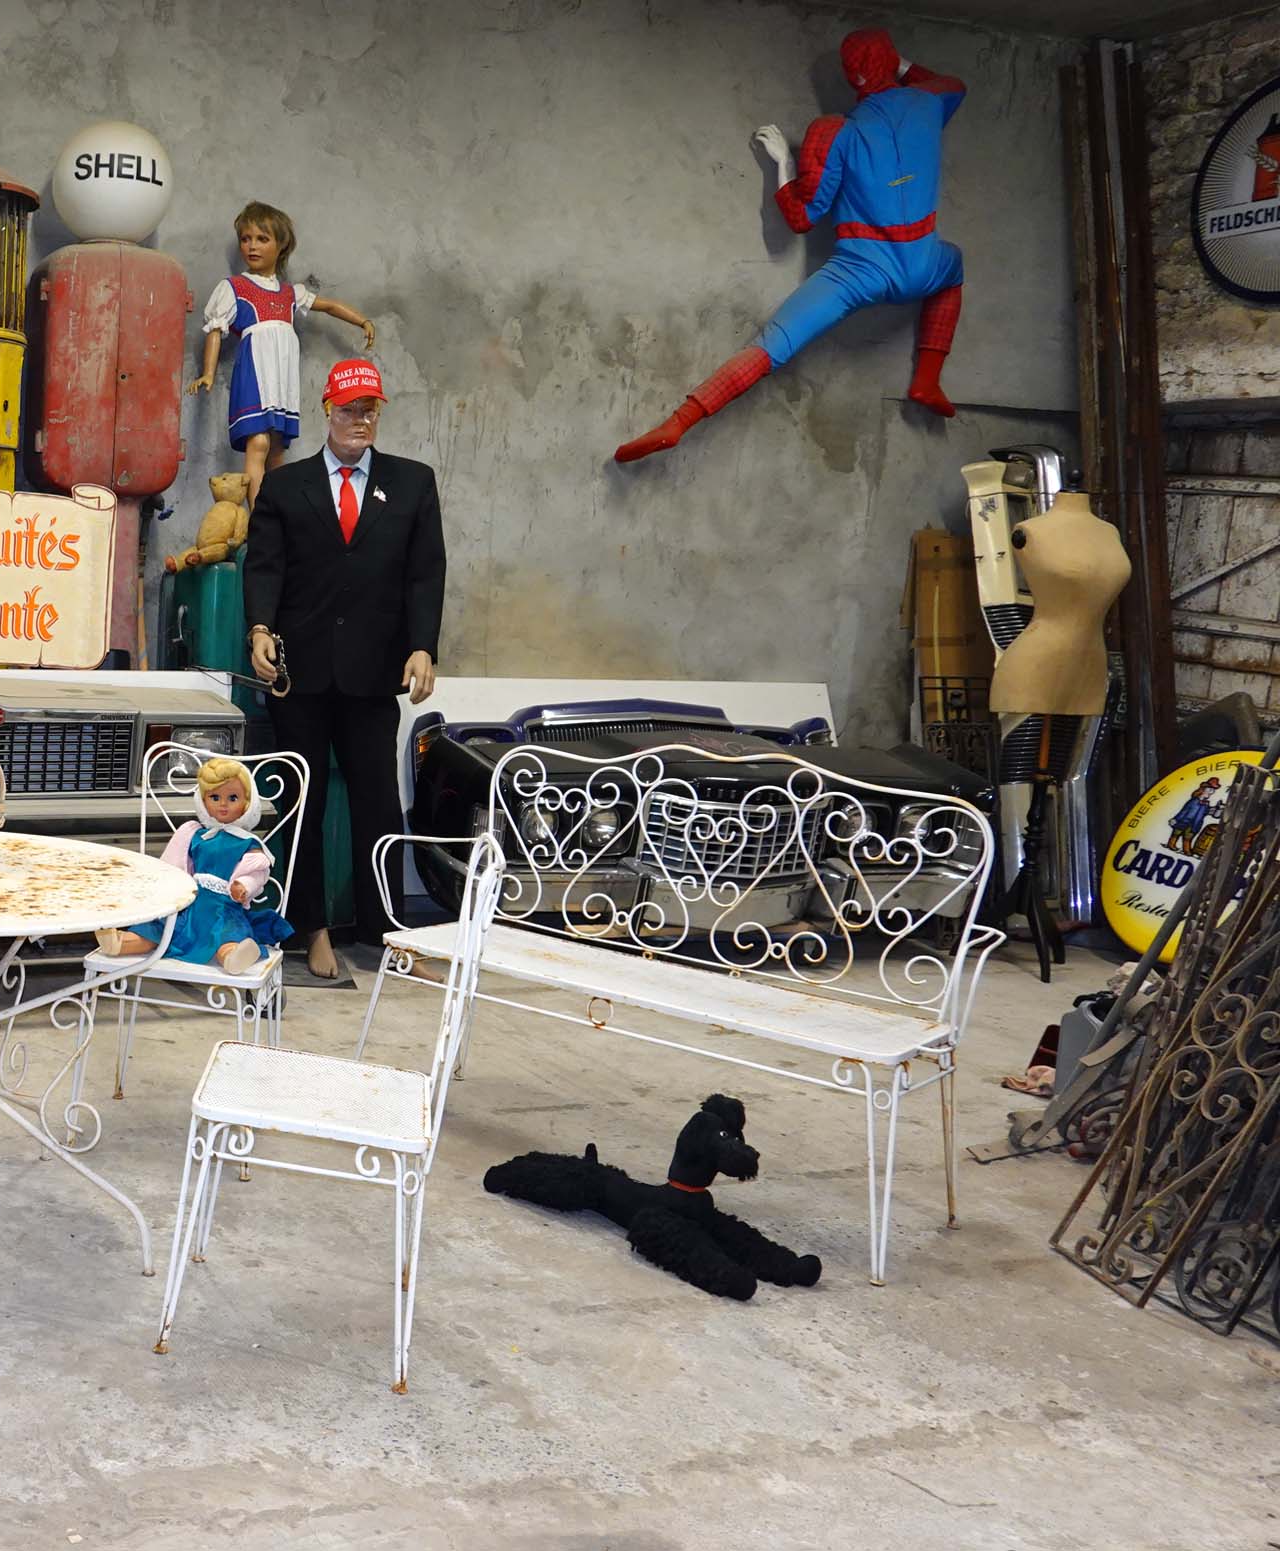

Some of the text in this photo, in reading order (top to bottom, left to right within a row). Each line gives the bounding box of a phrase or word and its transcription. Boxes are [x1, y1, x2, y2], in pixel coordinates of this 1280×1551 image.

[74, 153, 163, 186] SHELL
[334, 368, 353, 381] MAKE
[339, 378, 360, 389] GREAT
[1128, 784, 1170, 828] BIERE
